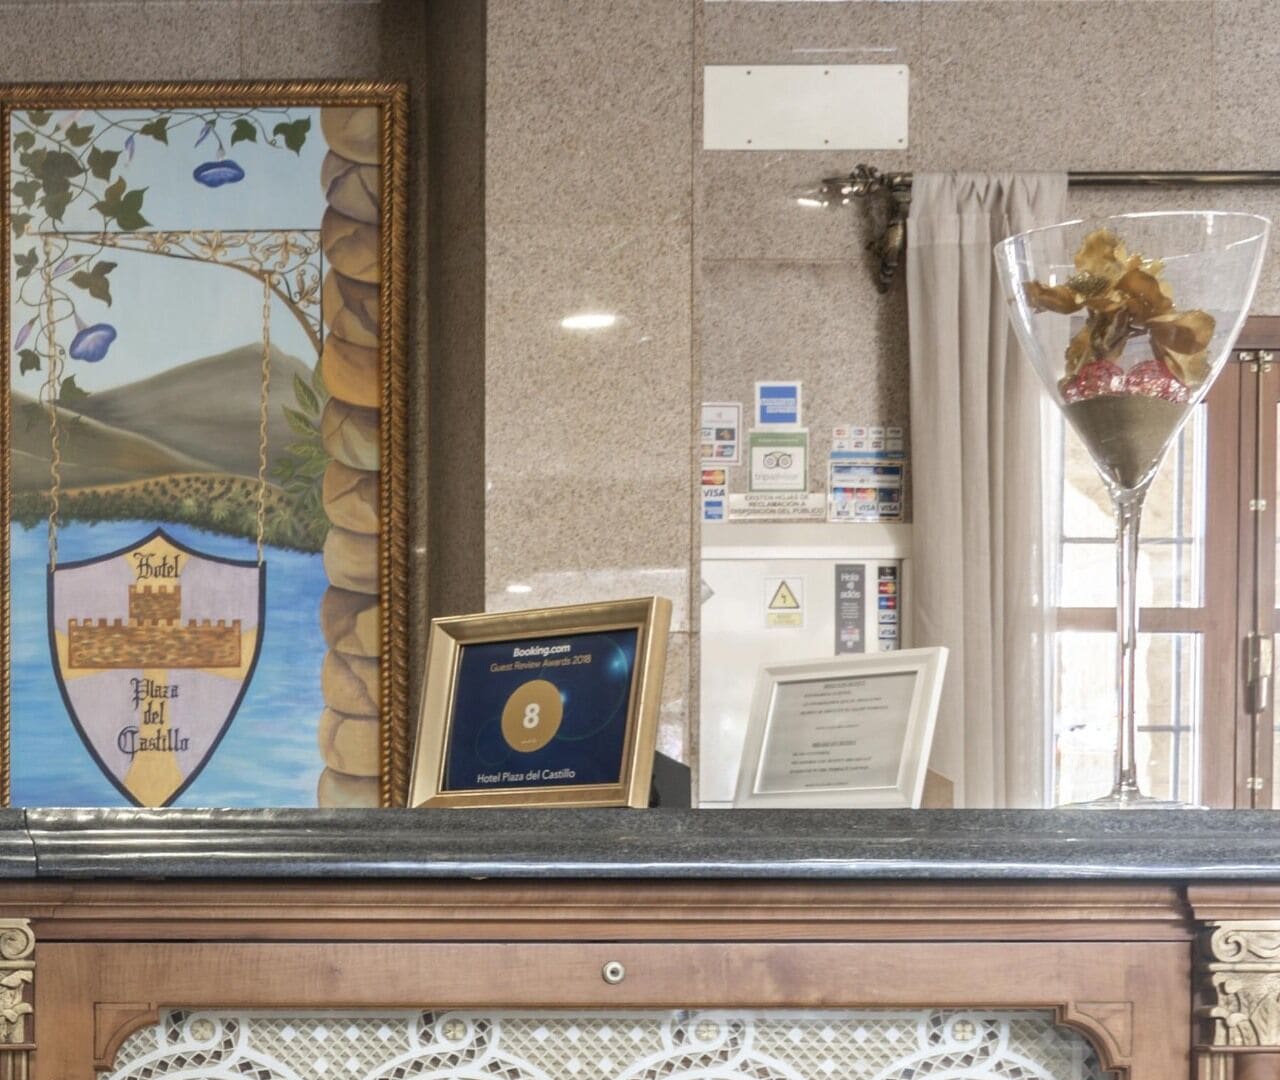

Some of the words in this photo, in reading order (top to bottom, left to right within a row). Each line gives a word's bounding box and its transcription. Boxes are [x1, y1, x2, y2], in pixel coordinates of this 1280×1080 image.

[704, 488, 725, 497] VISA
[133, 552, 181, 581] Hotel
[513, 645, 571, 657] Booking.com
[490, 662, 513, 673] Guest
[514, 659, 541, 669] Review
[542, 656, 571, 667] Awards
[571, 654, 592, 665] 2018
[130, 678, 178, 710] Plaza
[143, 700, 165, 724] del
[523, 703, 541, 729] 8
[118, 726, 190, 761] Castillo
[477, 772, 501, 783] Hotel
[502, 771, 524, 782] Plaza
[526, 770, 540, 781] del
[542, 768, 576, 780] Castillo
